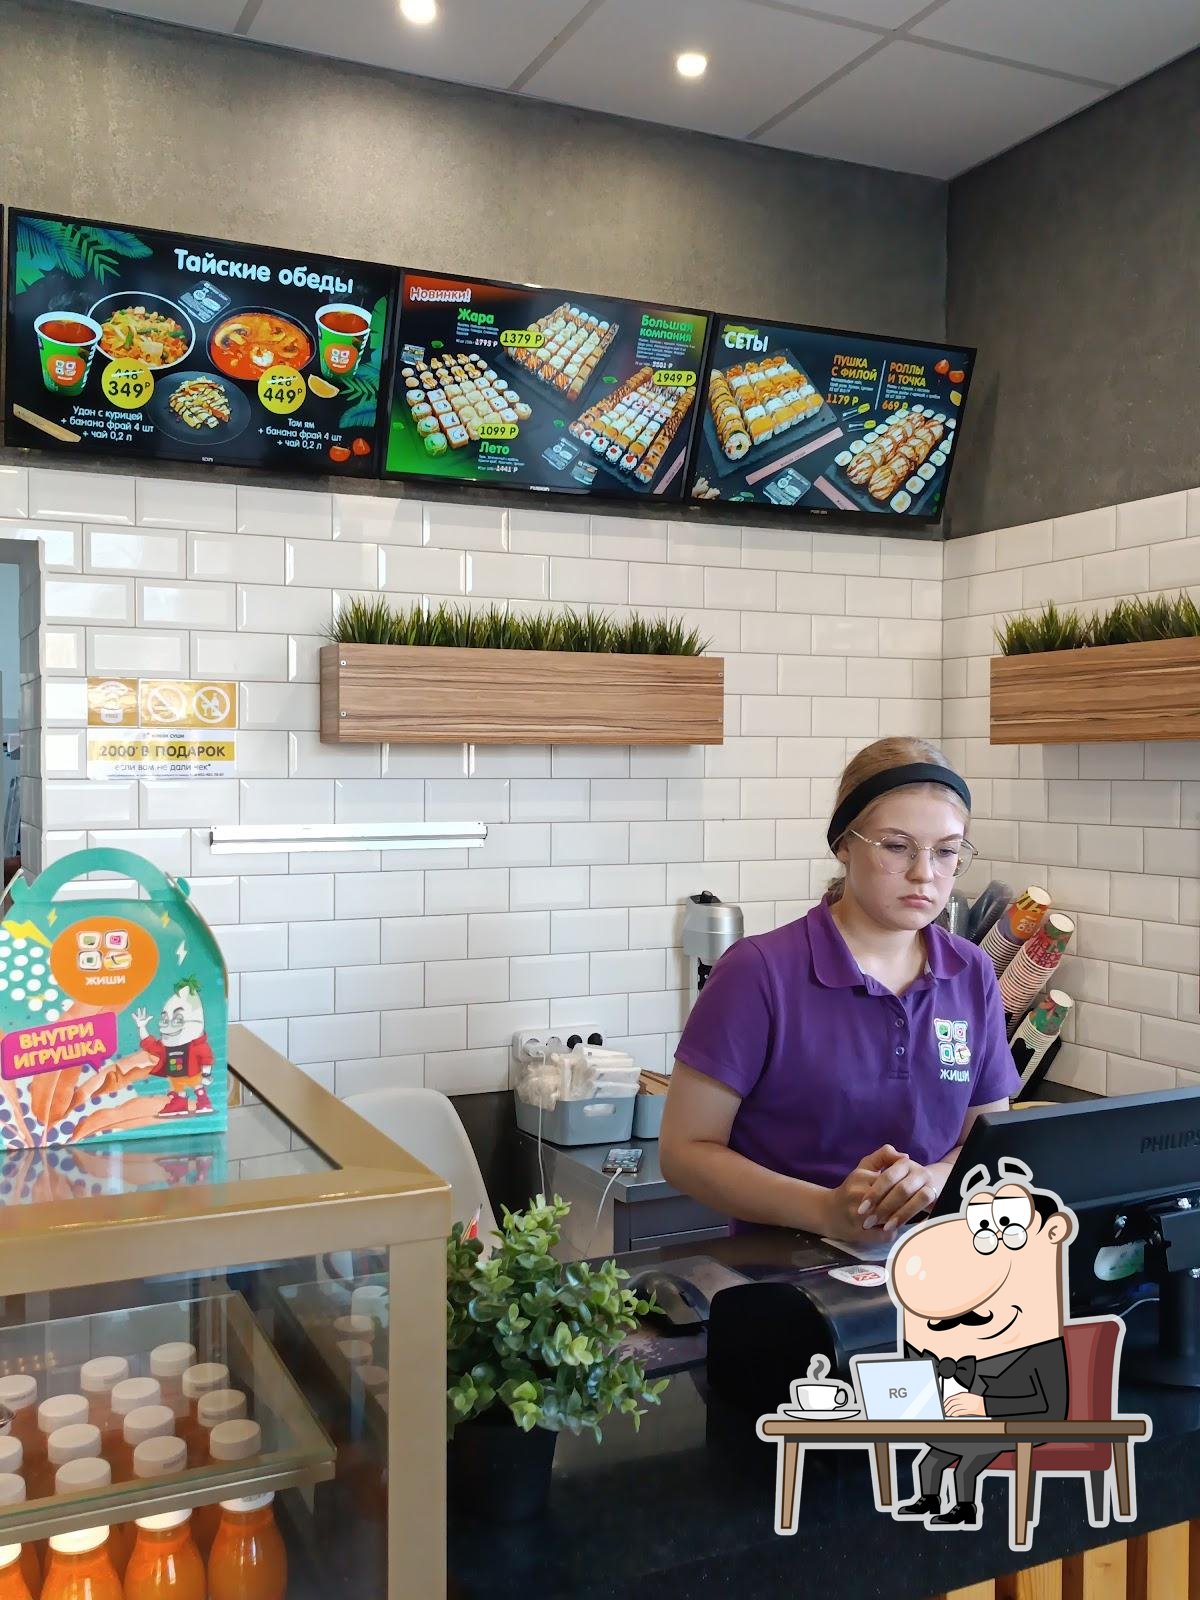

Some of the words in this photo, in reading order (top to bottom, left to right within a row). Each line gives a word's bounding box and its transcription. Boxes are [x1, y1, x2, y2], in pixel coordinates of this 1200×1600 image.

[174, 248, 271, 282] Тайские
[278, 266, 354, 294] обеды
[410, 286, 471, 302] Новинки!
[458, 308, 494, 326] Жара
[642, 314, 694, 332] Большая
[503, 333, 530, 344] 1379
[640, 329, 692, 342] компания
[725, 331, 768, 352] СЕТЫ
[833, 355, 868, 368] ПУШКА
[832, 367, 838, 376] С
[841, 367, 878, 381] ФИЛОЙ
[890, 362, 924, 375] РОЛЛЫ
[657, 373, 682, 382] 1949
[888, 374, 896, 383] И
[898, 374, 926, 386] ТОЧКА
[826, 394, 850, 404] 1179
[882, 400, 899, 410] 669
[72, 406, 96, 416] Удон
[105, 410, 142, 421] курицей
[106, 420, 131, 431] фрай
[134, 423, 139, 431] 4
[288, 418, 302, 428] Том
[91, 430, 107, 438] чай
[110, 431, 124, 441] 0,2
[299, 429, 322, 440] фрай
[324, 432, 330, 440] 4
[480, 426, 506, 436] 1099
[302, 440, 314, 450] 0,2
[479, 441, 510, 455] Лето
[141, 746, 149, 756] В
[155, 745, 225, 758] ПОДАРОК
[19, 1022, 94, 1049] ВНУТРИ
[13, 1039, 106, 1070] ИГРУШКА
